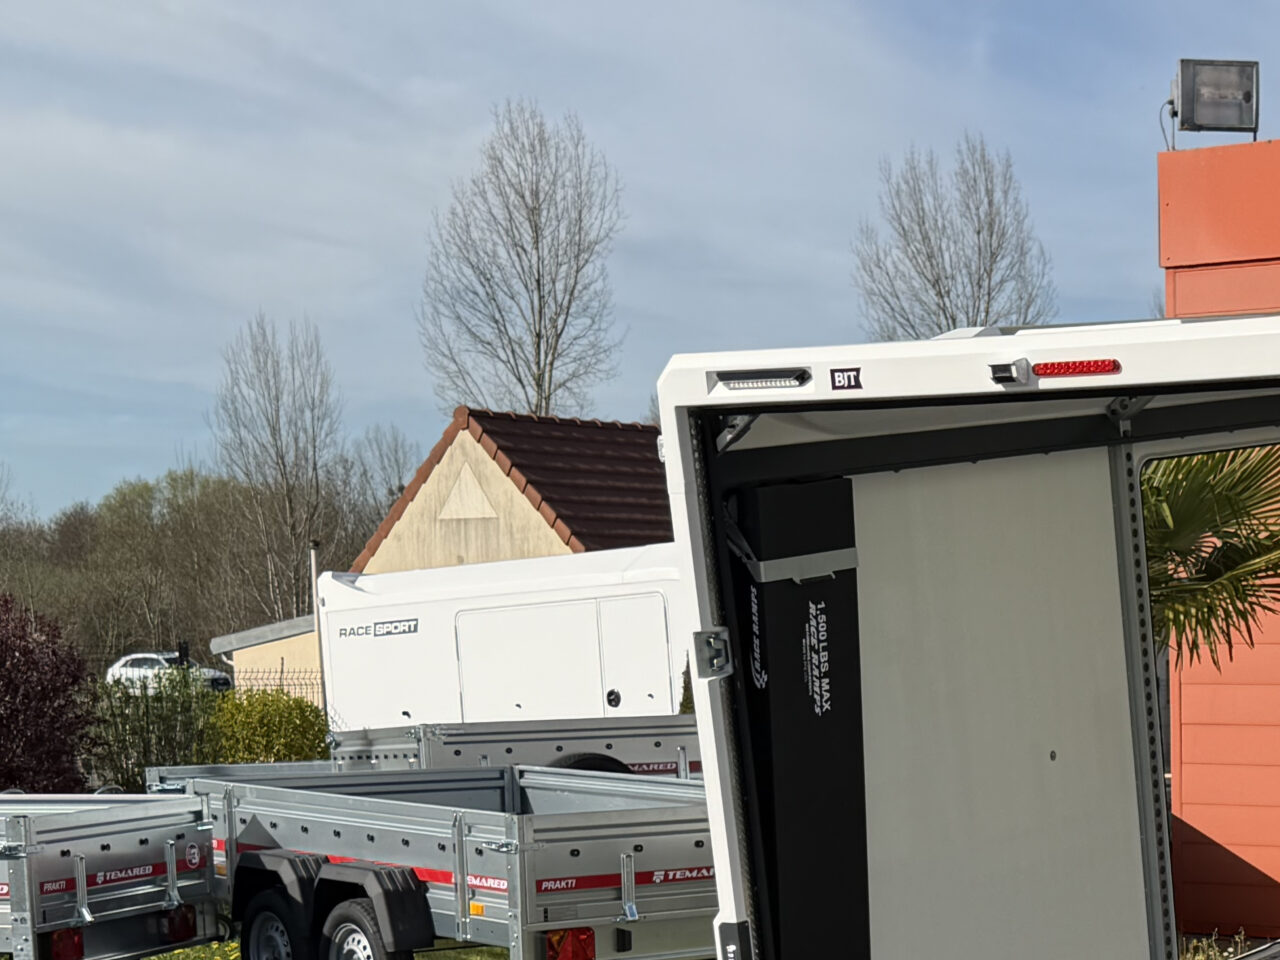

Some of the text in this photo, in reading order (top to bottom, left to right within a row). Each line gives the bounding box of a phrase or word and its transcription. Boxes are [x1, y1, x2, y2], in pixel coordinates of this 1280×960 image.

[833, 371, 857, 388] BJT
[339, 620, 417, 638] RACE SPORT
[808, 600, 819, 650] RACE
[819, 642, 829, 677] LBS.
[811, 651, 822, 717] RAMPS
[820, 678, 832, 712] MAX
[628, 762, 677, 772] MARED
[43, 865, 153, 892] PRAKTI TEMARED
[467, 875, 508, 889] EMARED
[541, 878, 577, 891] PRAKTI
